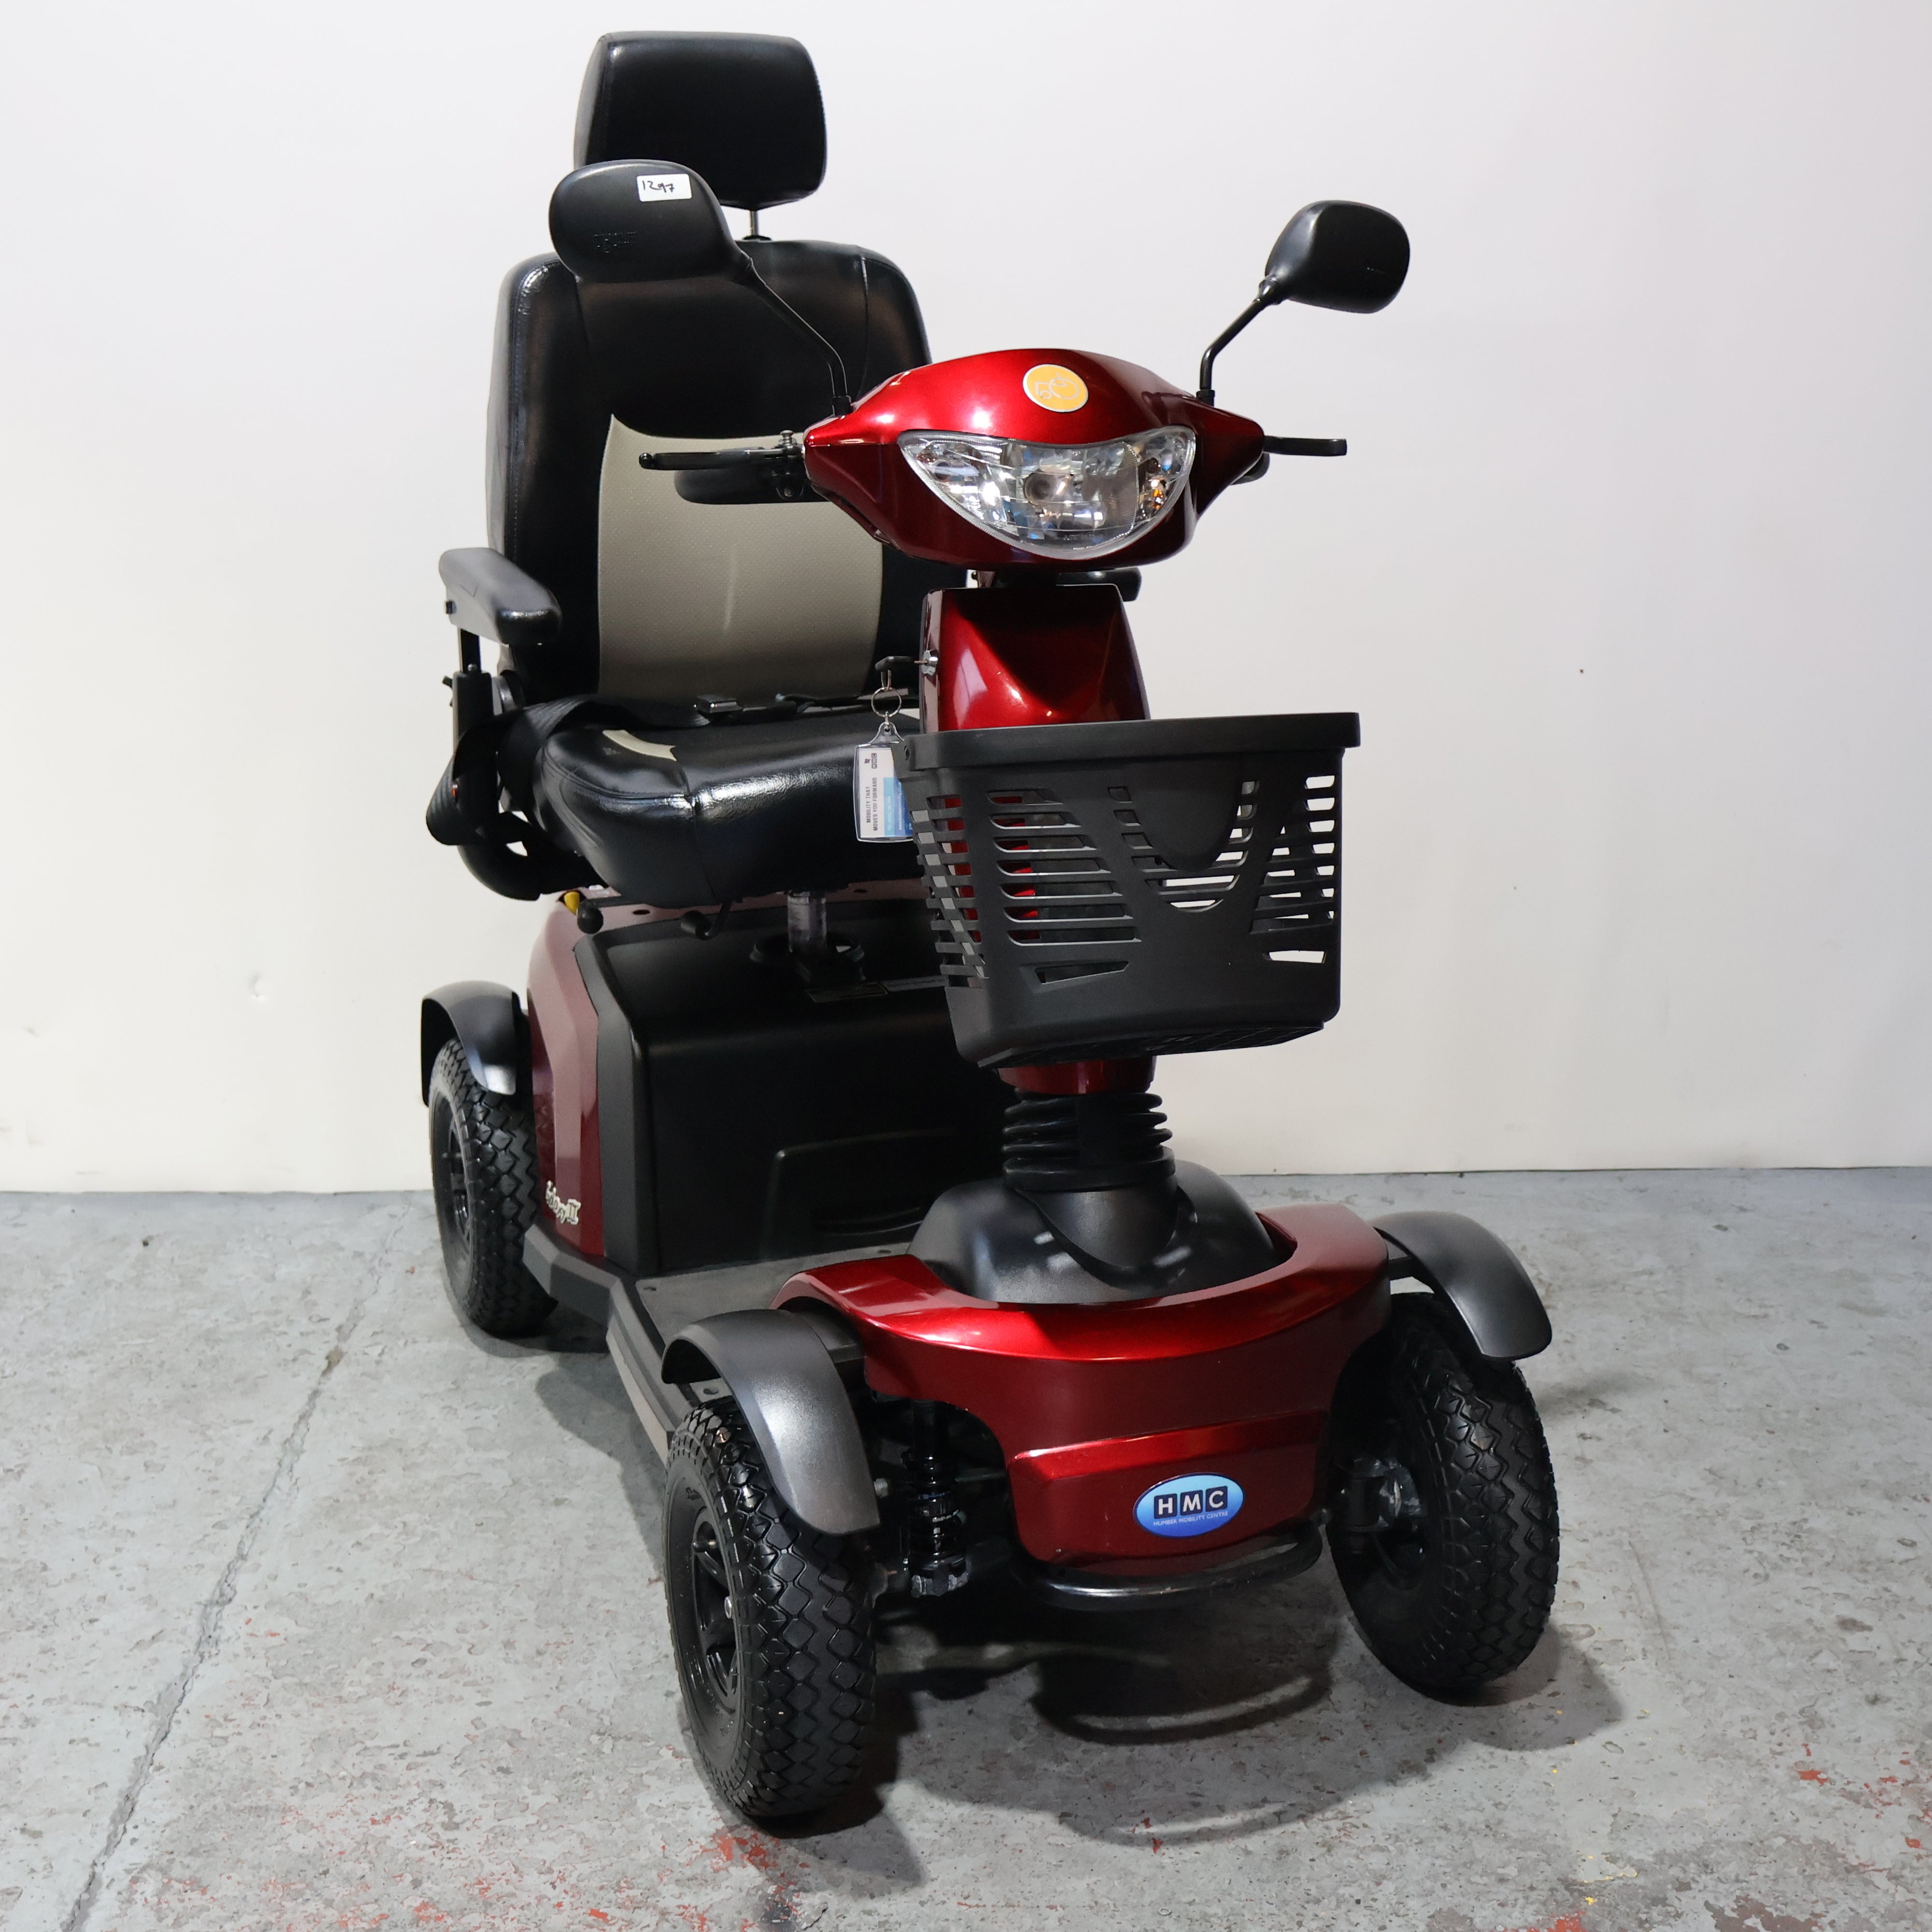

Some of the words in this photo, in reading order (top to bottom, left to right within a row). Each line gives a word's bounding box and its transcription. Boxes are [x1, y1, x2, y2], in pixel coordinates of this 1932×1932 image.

[642, 180, 675, 193] 1297
[1157, 1489, 1225, 1516] HMC
[1179, 1515, 1205, 1523] MOBILITY
[1207, 1511, 1228, 1519] CENTRE
